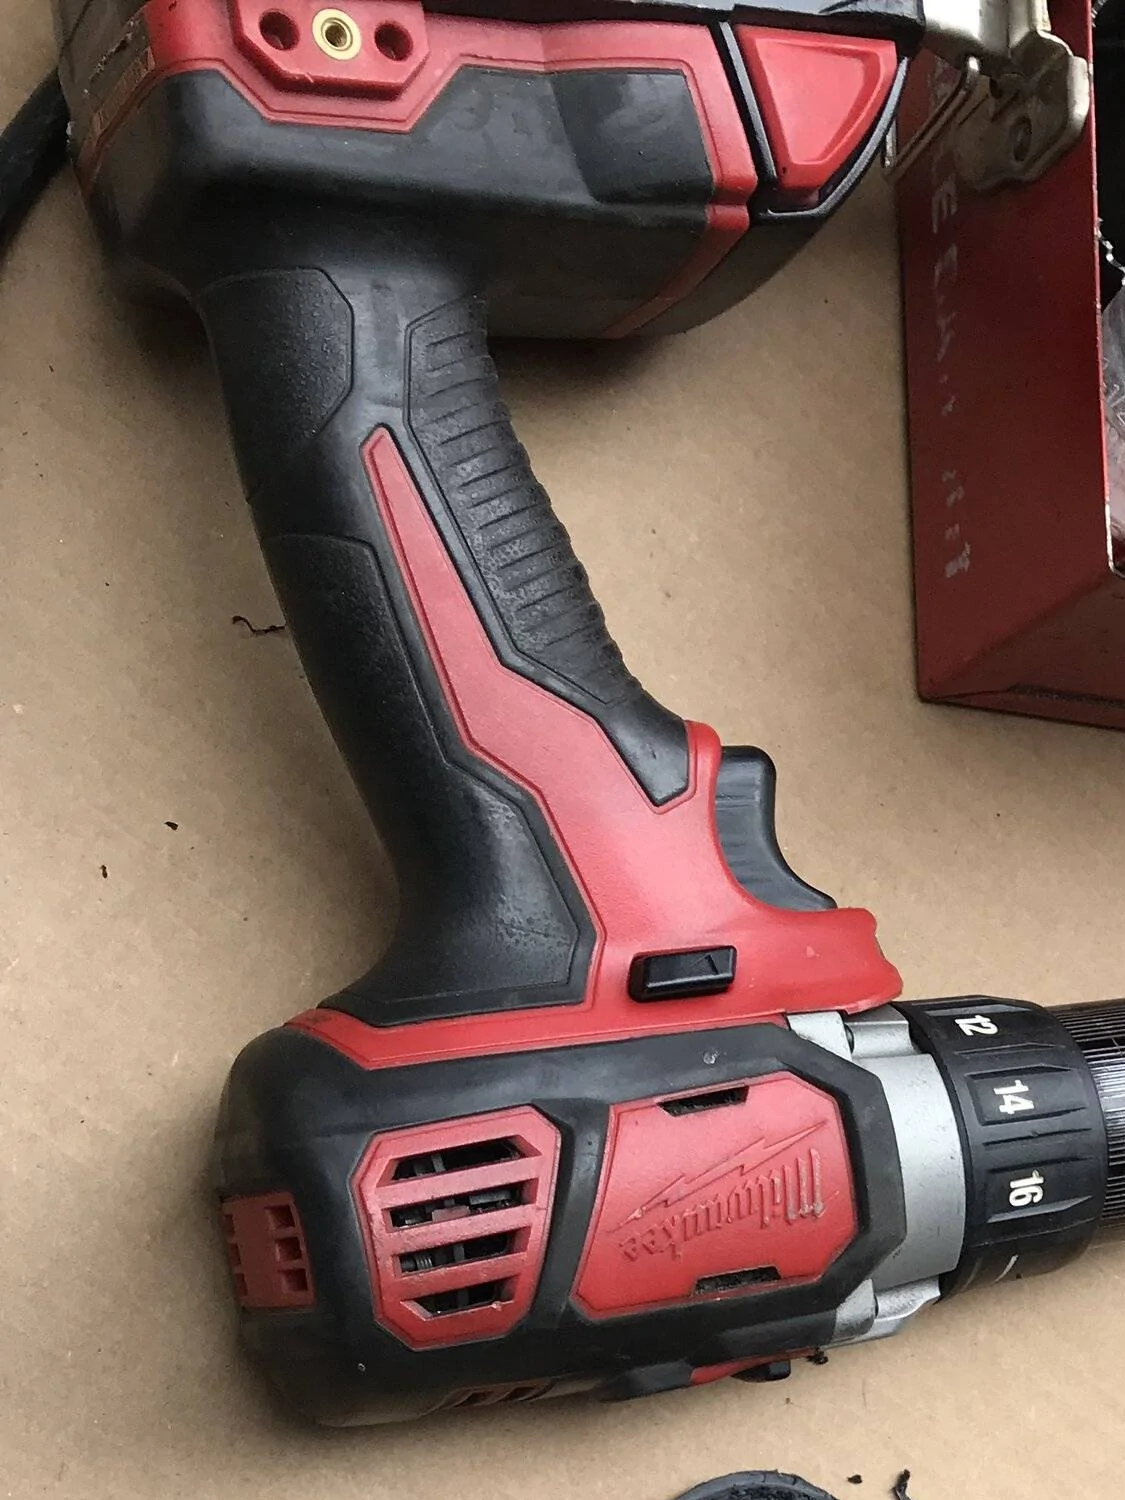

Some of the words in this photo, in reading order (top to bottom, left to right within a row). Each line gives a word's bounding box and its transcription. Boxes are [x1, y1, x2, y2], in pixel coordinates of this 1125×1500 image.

[954, 1014, 999, 1037] 12
[993, 1079, 1035, 1115] 14
[617, 1147, 827, 1263] Milwaukee
[1009, 1169, 1045, 1207] 16
